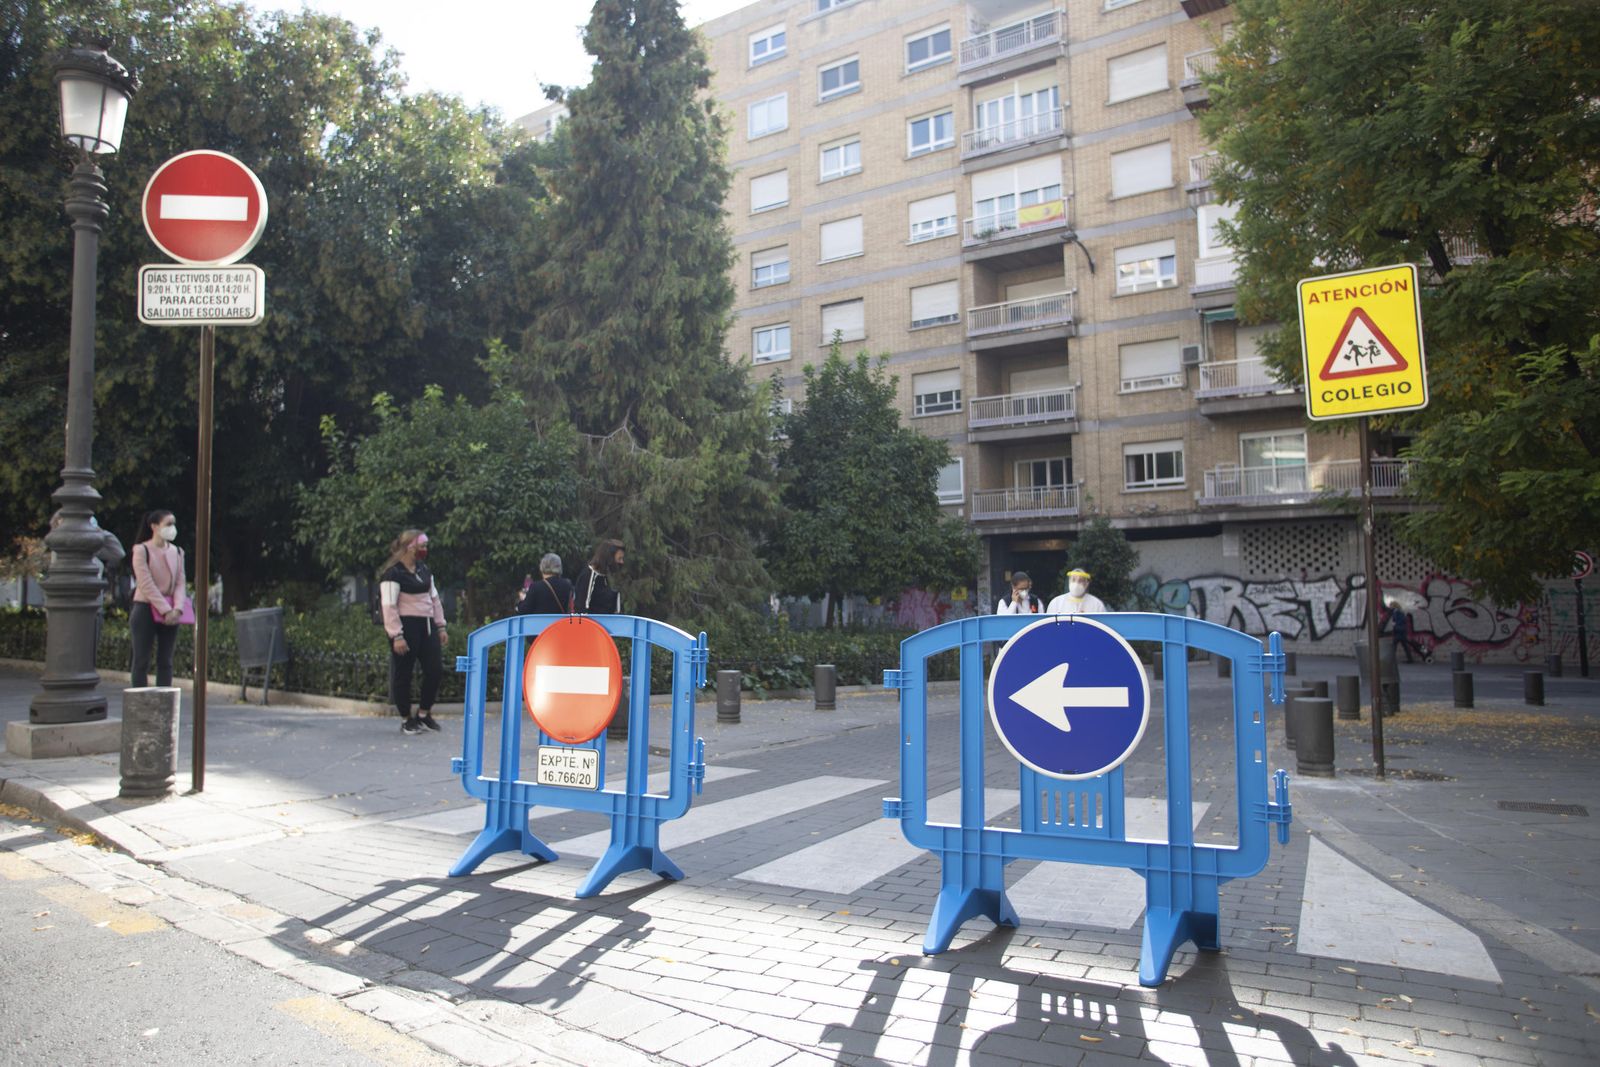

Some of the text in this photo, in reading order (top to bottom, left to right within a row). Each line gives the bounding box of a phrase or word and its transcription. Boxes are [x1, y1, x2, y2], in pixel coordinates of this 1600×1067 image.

[147, 273, 251, 283] DÍAS LECTIVOS DE 8:40 A
[147, 285, 251, 294] 9:20 H. Y DE 13:40 A 14:20 H.
[1308, 278, 1408, 305] ATENCIÓN
[160, 296, 239, 305] PARA ACCESO Y
[147, 308, 251, 318] SALIDA DE ESCOLARES
[1321, 381, 1412, 403] COLEGIO
[541, 754, 579, 768] EXPTE.
[543, 770, 591, 785] 16.766/20
